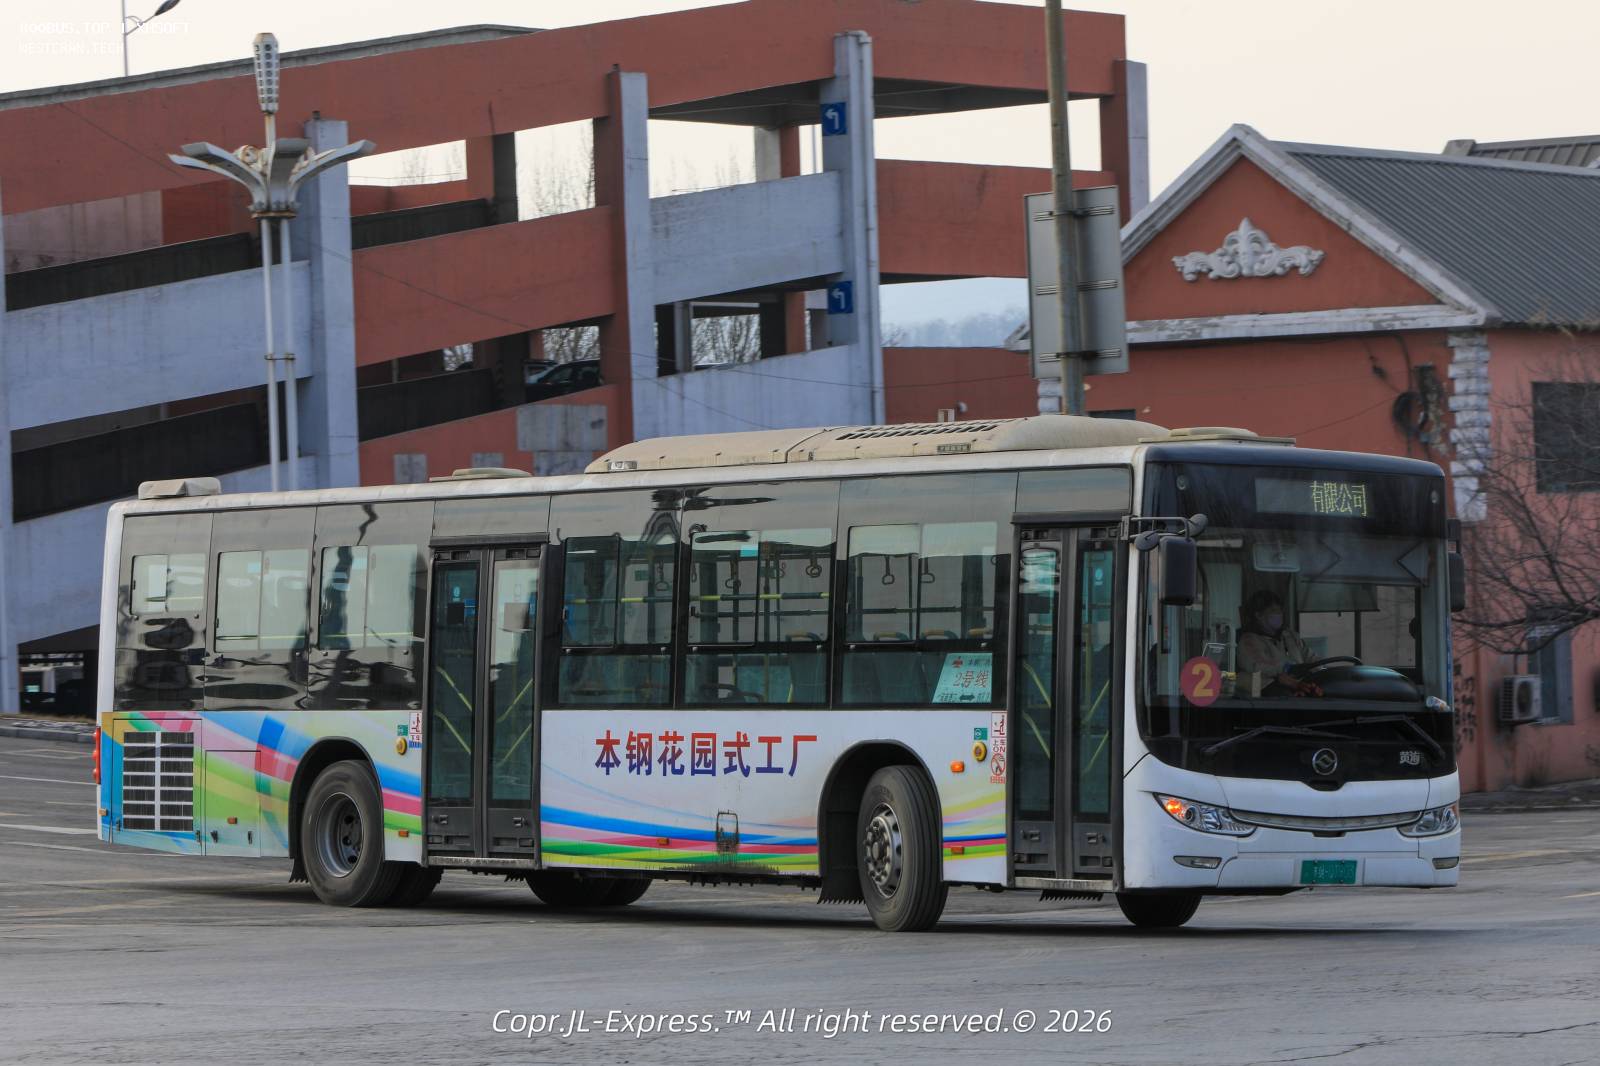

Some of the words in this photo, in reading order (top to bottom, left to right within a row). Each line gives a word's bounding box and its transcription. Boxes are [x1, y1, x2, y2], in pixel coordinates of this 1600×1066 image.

[1310, 480, 1367, 517] 有限公司
[1191, 663, 1214, 697] 2
[594, 729, 818, 778] 本钢花园式工厂
